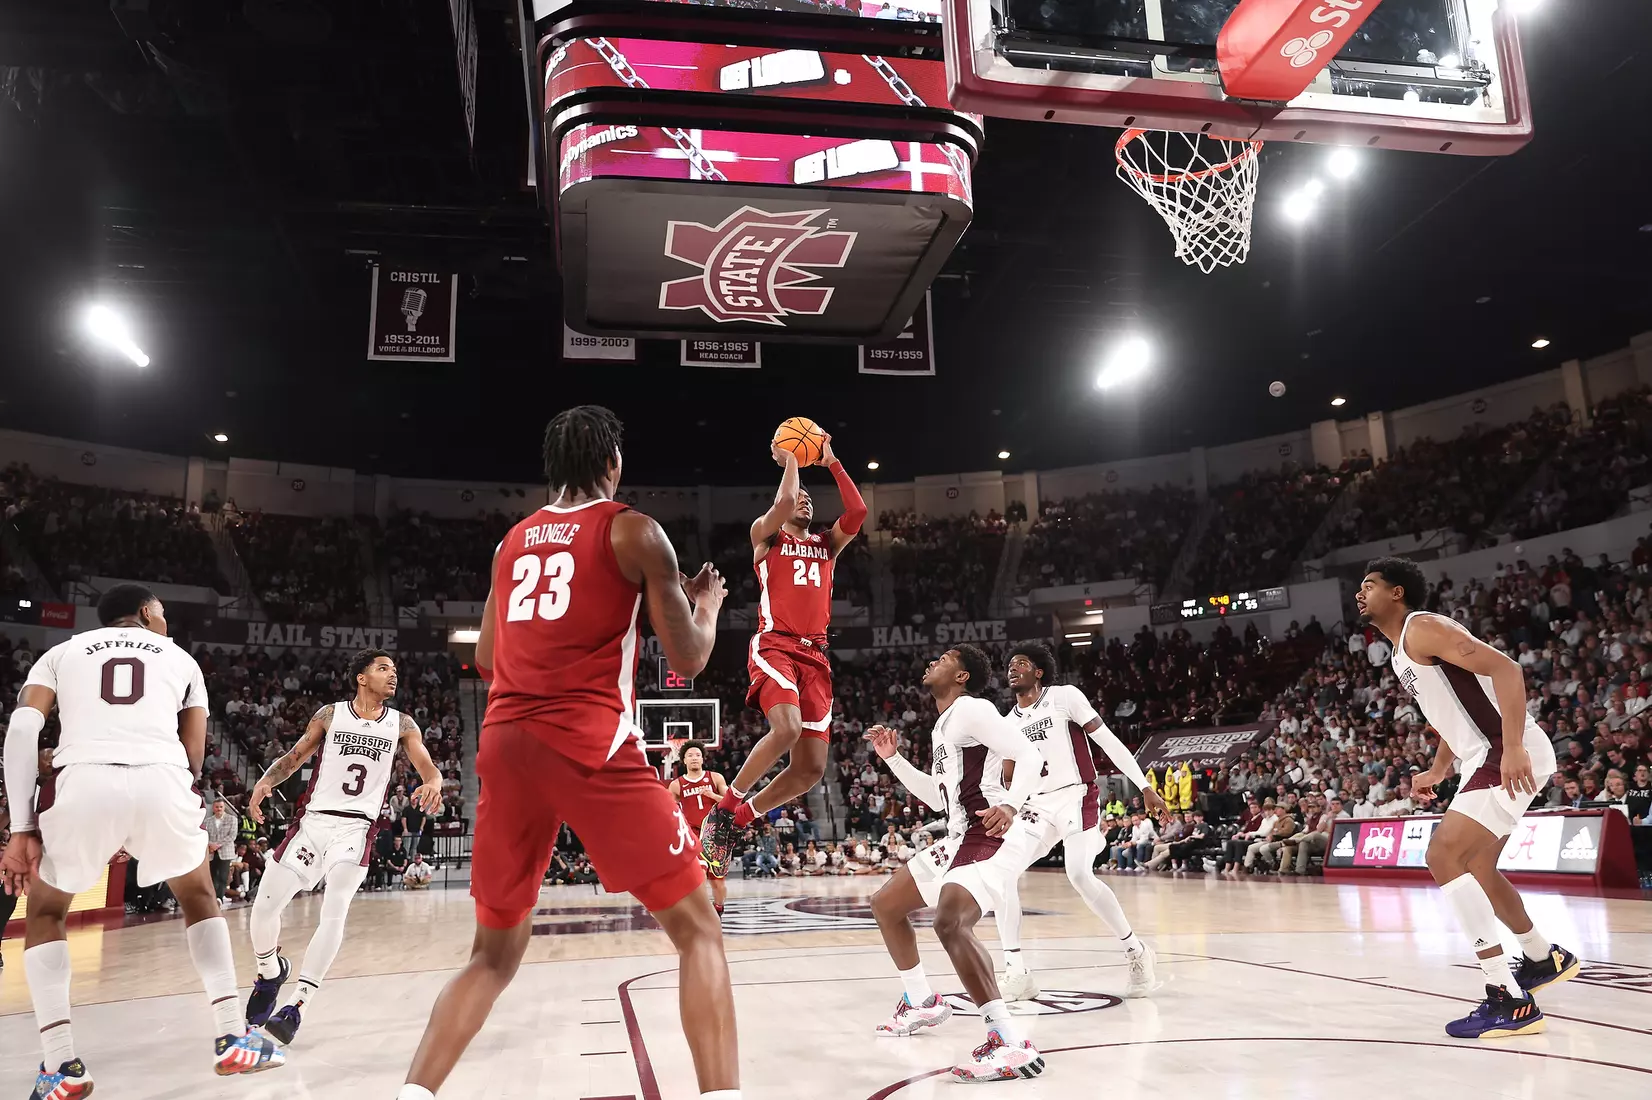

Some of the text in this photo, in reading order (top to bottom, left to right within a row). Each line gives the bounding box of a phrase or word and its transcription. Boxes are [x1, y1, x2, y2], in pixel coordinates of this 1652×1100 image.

[390, 271, 441, 284] CRISTIL
[718, 235, 786, 308] STATE
[384, 334, 441, 345] 1953-2011
[570, 337, 629, 348] 1999-2003
[693, 341, 749, 352] 1956-1965
[379, 345, 400, 353] VOICE
[408, 346, 446, 354] BULLDOGS
[699, 352, 719, 360] HEAD
[870, 349, 924, 360] 1957-1959
[524, 523, 580, 549] PRINGLE
[780, 543, 829, 560] ALABAMA
[793, 559, 821, 588] 24
[506, 551, 575, 623] 23
[246, 622, 398, 650] HAIL STATE
[872, 620, 1007, 647] HAIL STATE
[85, 640, 163, 655] JEFFRIES
[101, 657, 145, 705] 0
[333, 733, 392, 751] MISSISSIPPI
[1162, 730, 1258, 748] MISSISSIPPI
[346, 746, 375, 757] STATE
[1174, 744, 1220, 754] STATE
[342, 763, 368, 797] 3
[697, 795, 704, 810] 1
